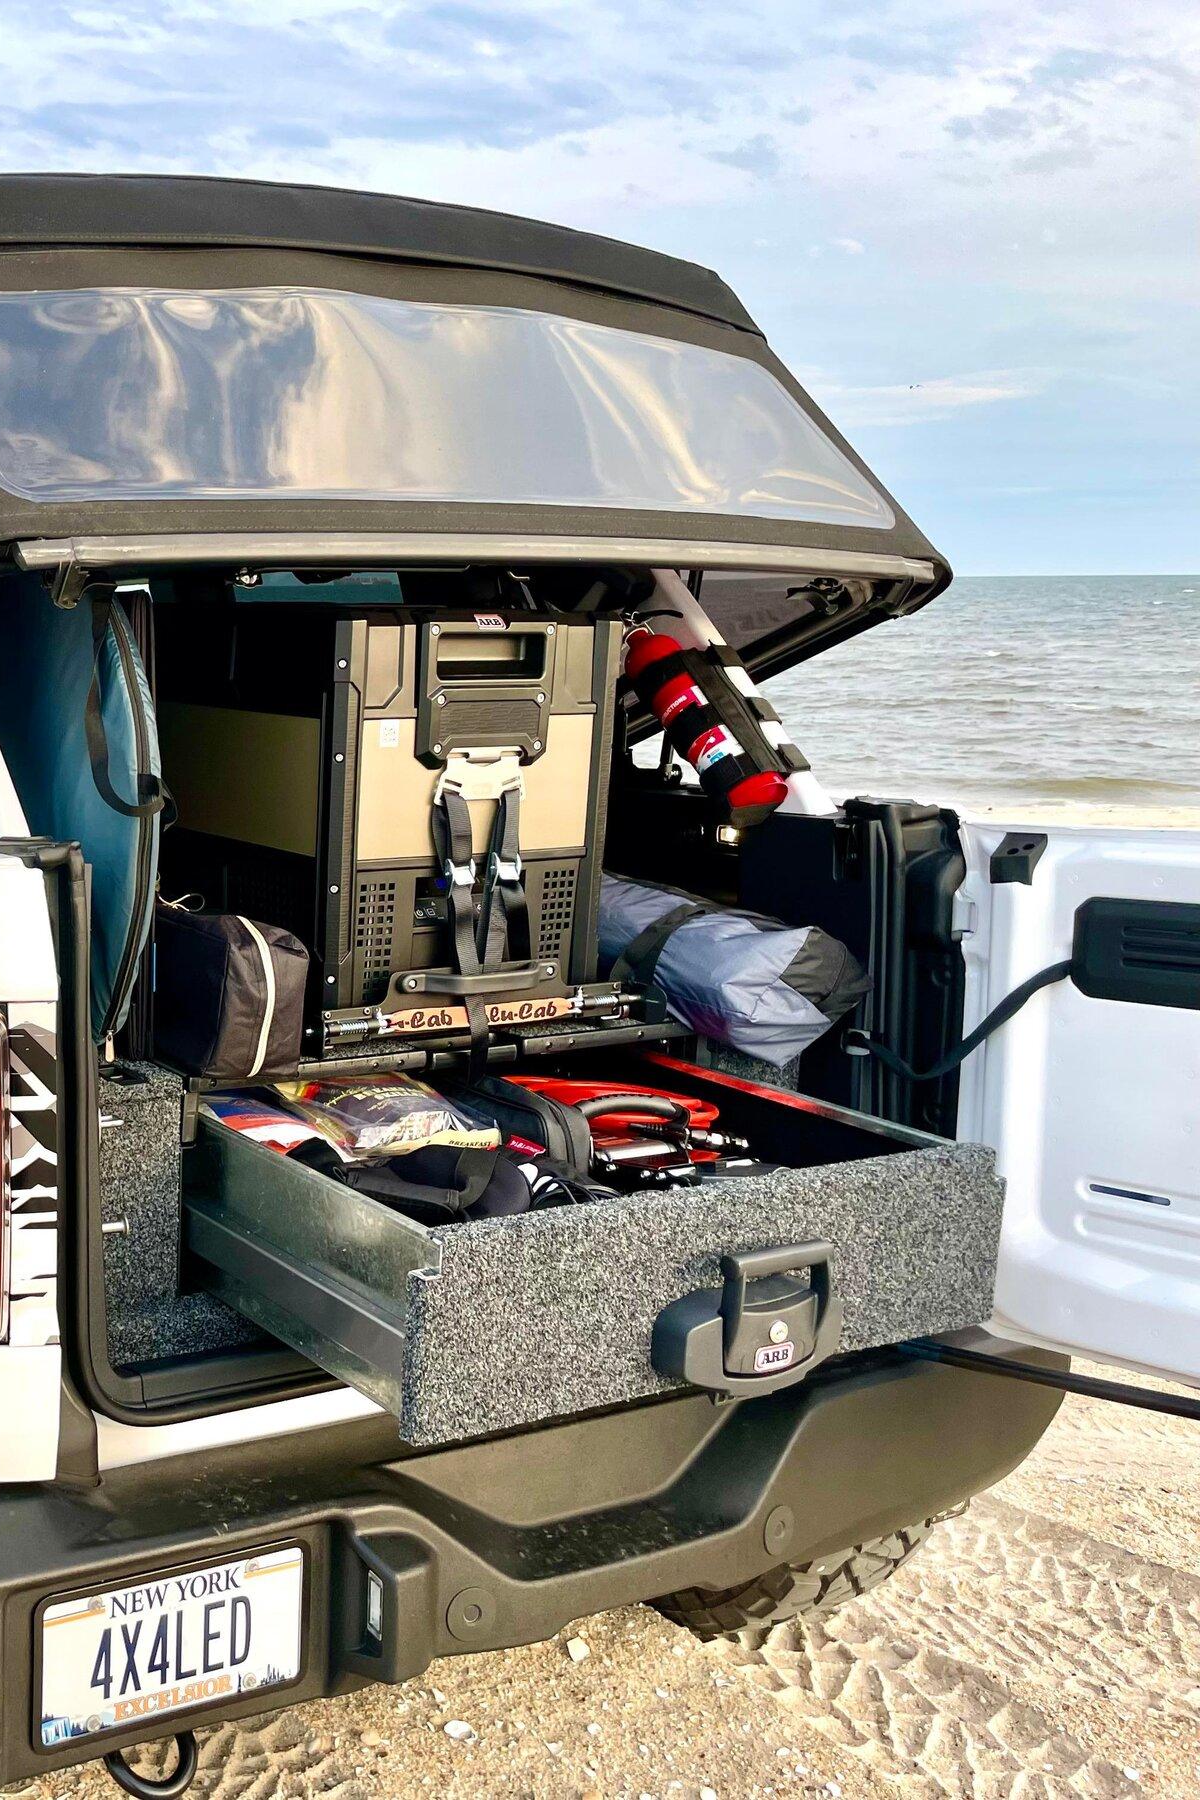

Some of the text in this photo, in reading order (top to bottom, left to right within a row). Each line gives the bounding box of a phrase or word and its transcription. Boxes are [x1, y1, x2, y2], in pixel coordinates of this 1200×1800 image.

[478, 618, 502, 626] ARB
[486, 1001, 558, 1024] lu-Cab
[448, 1139, 492, 1147] BREAKFAST
[761, 1348, 789, 1365] ARB
[108, 1566, 241, 1620] NEW YORK
[90, 1595, 252, 1700] 4X4LED
[113, 1674, 234, 1722] EXCELSIOR
